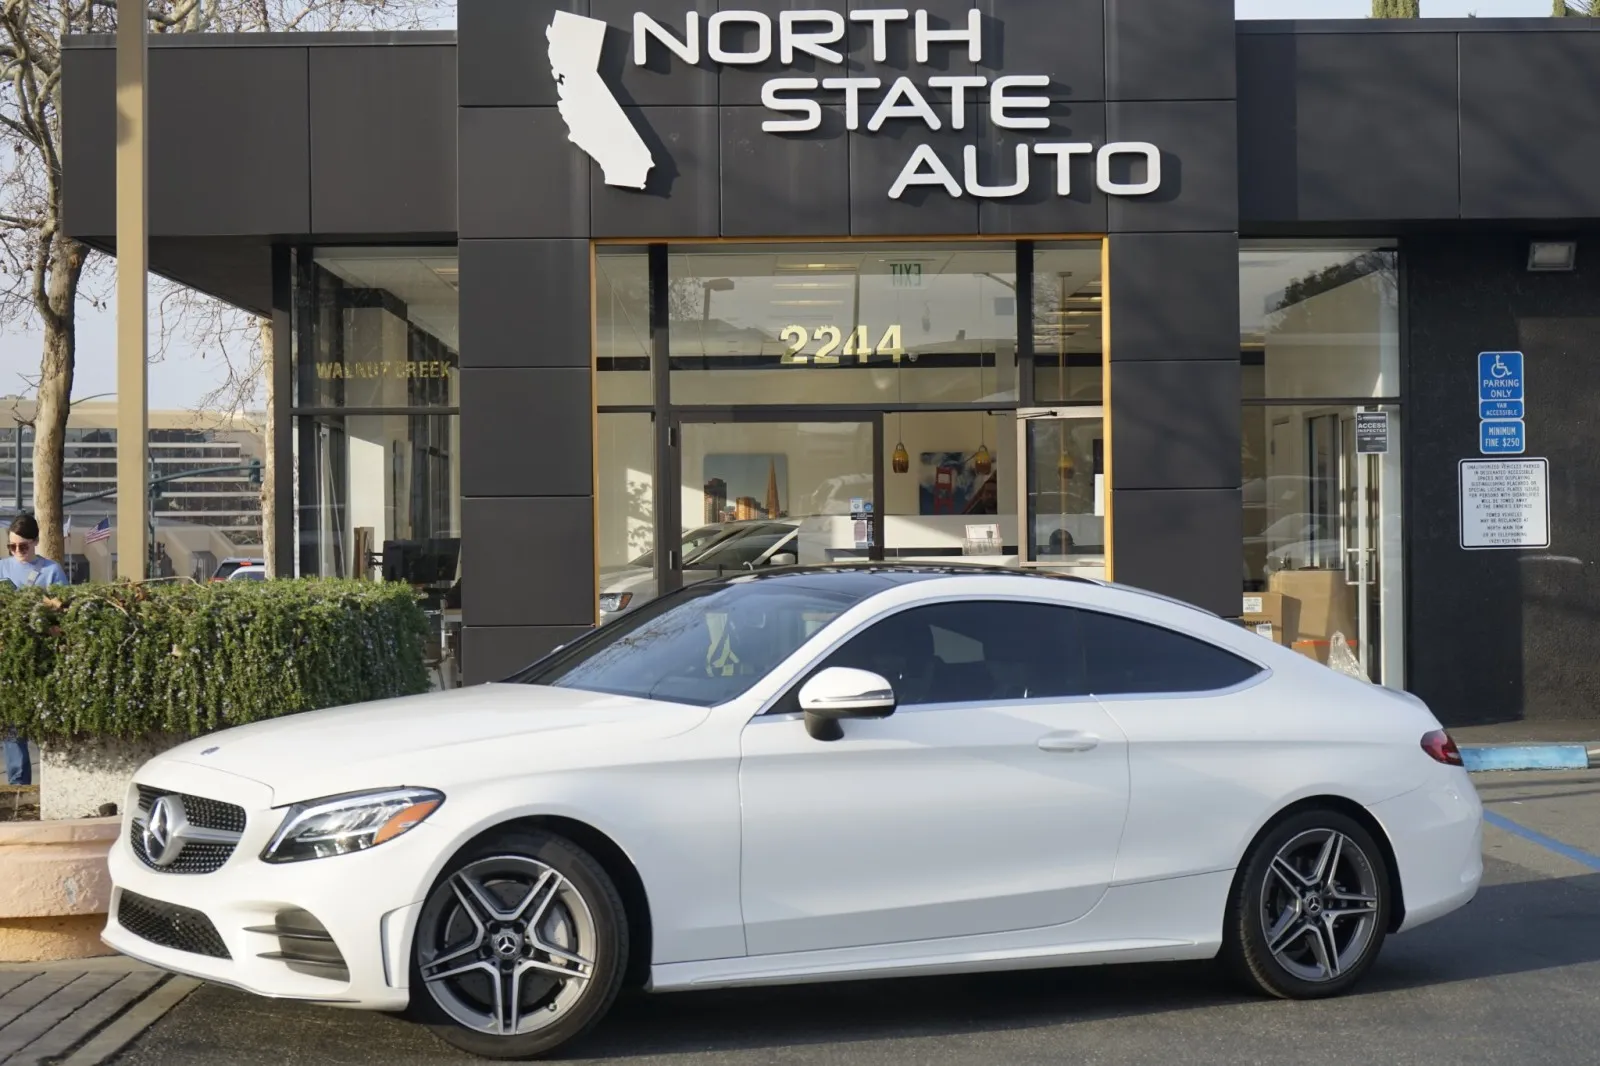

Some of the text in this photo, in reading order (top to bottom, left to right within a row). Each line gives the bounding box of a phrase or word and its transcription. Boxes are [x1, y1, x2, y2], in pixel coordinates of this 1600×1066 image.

[633, 8, 981, 65] NORTH
[761, 75, 1051, 132] STATE
[887, 141, 1161, 199] AUTO
[778, 324, 905, 364] 2244
[316, 360, 451, 379] WALNUT CREEK
[1483, 379, 1520, 388] PARKING
[1490, 389, 1512, 398] ONLY
[1488, 426, 1516, 436] MINIMUM
[1485, 437, 1520, 447] FINE $250
